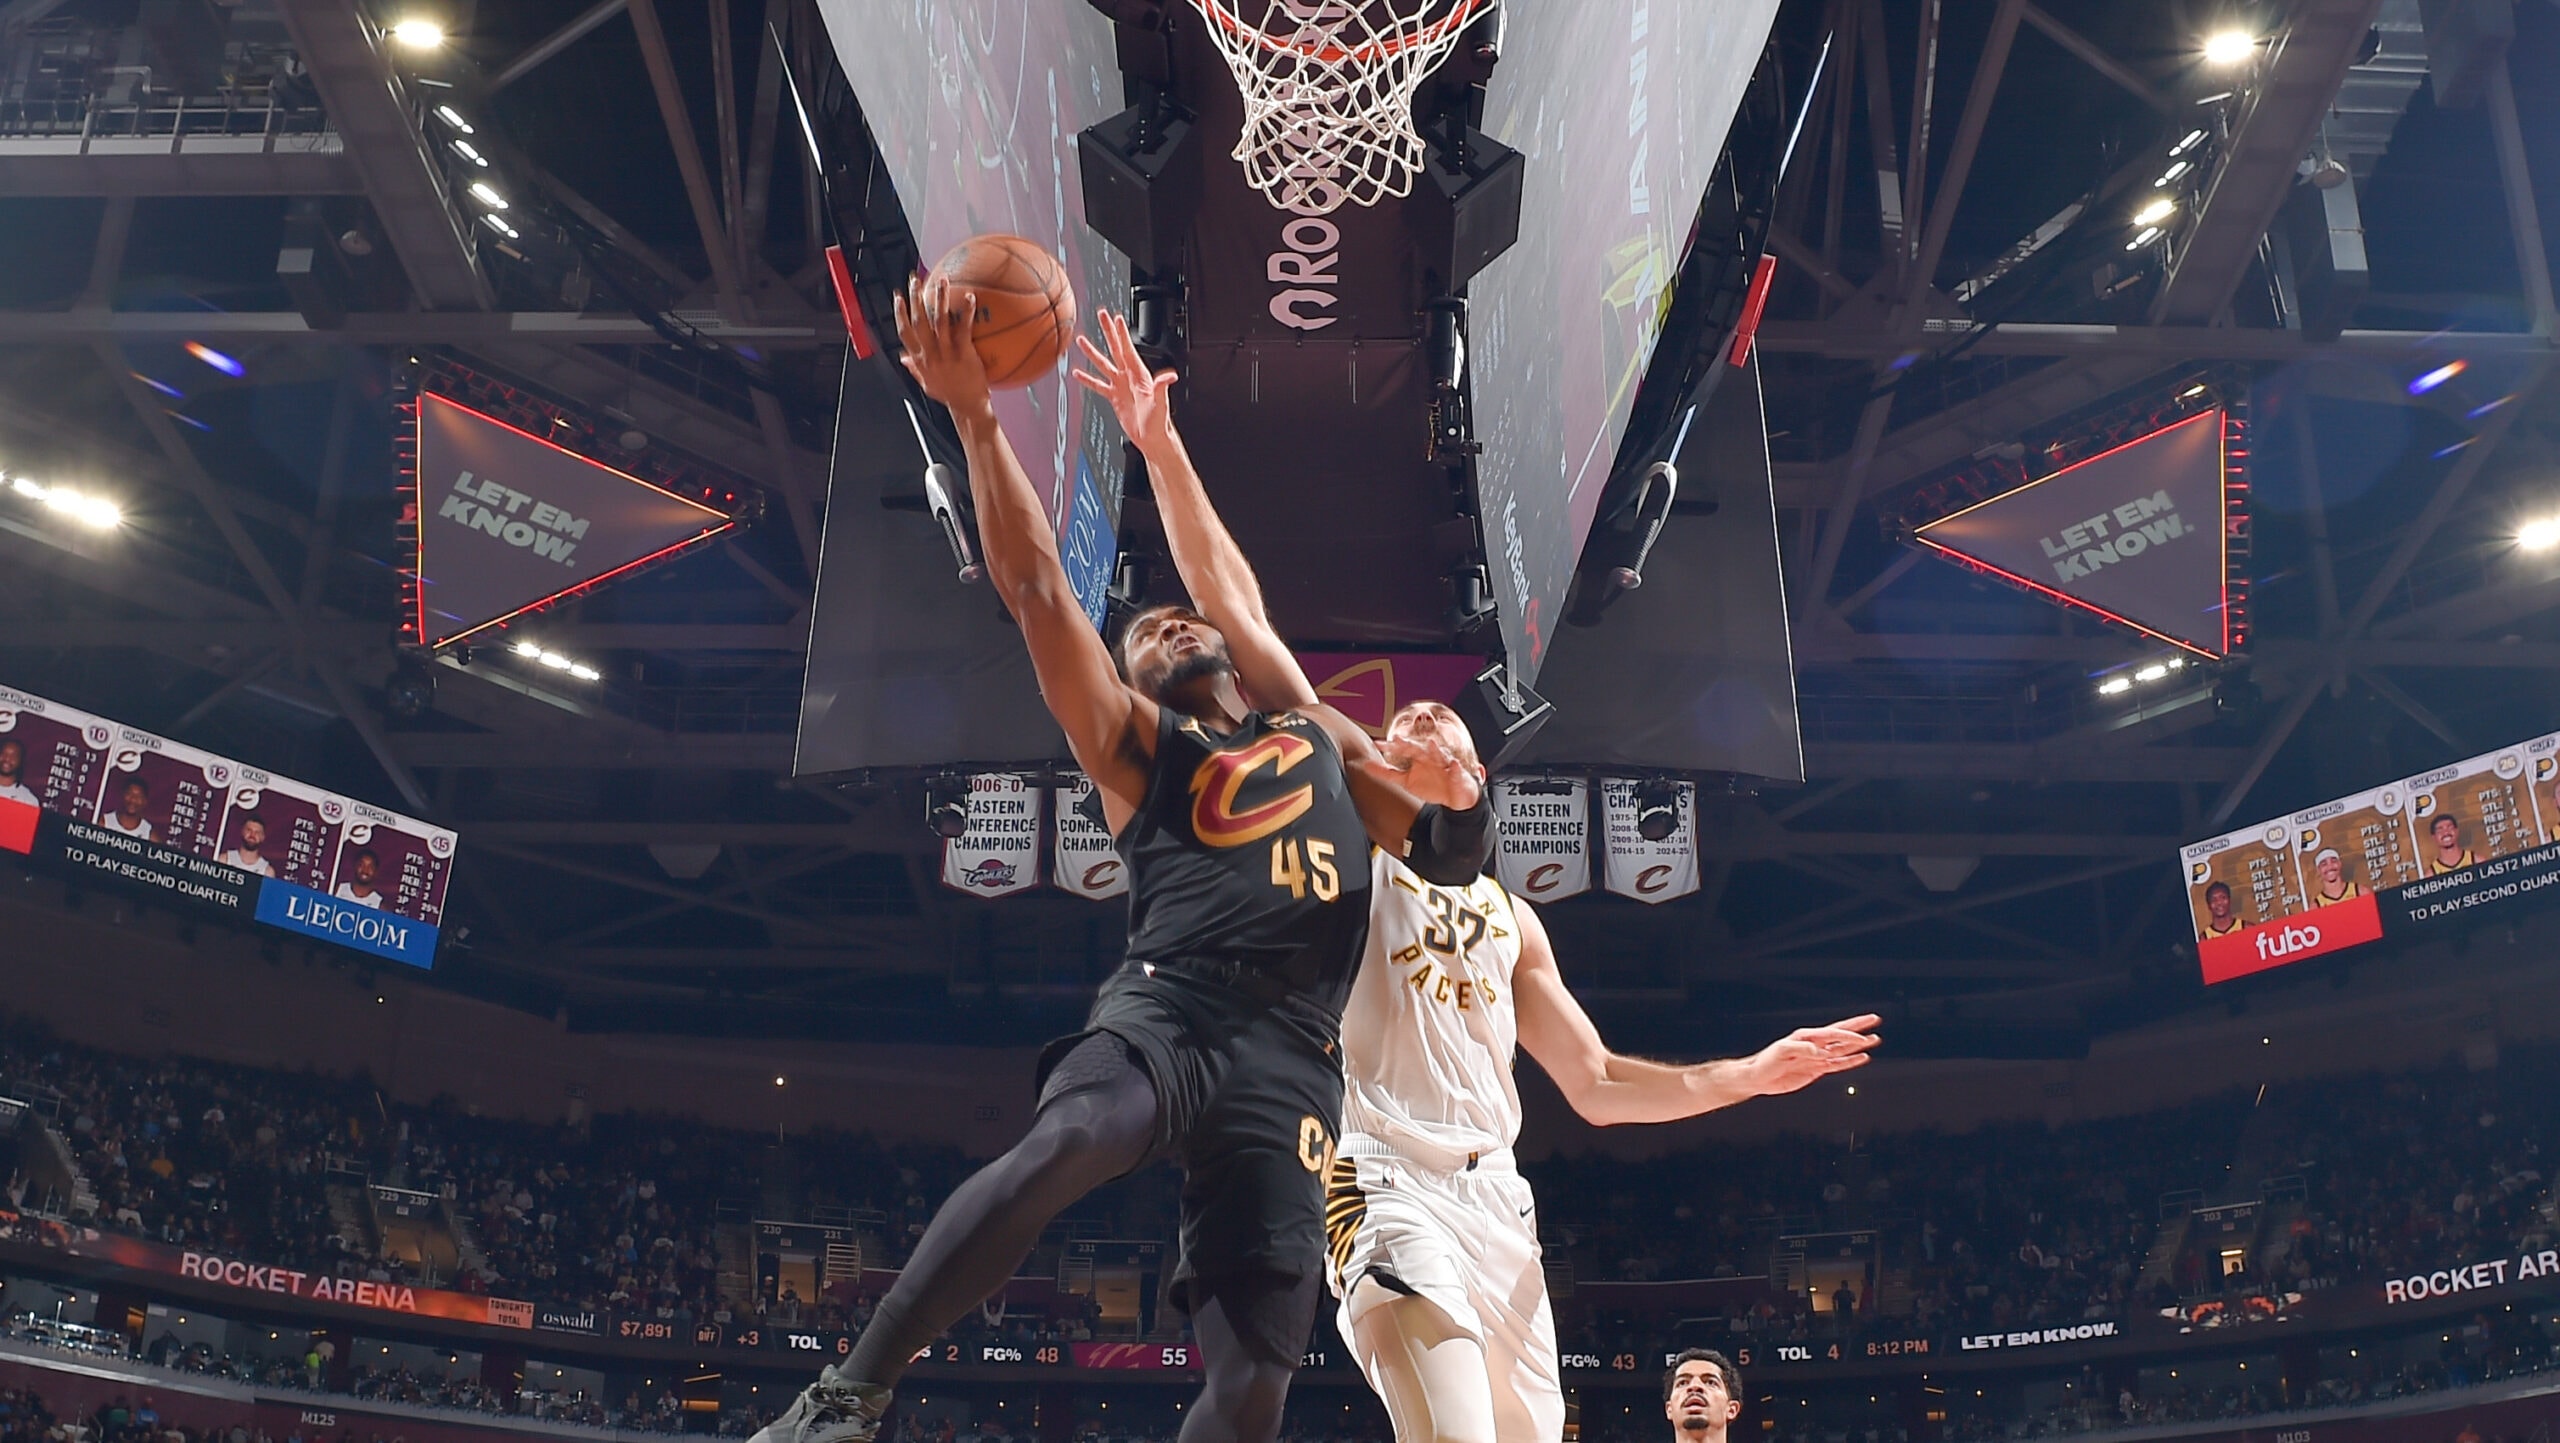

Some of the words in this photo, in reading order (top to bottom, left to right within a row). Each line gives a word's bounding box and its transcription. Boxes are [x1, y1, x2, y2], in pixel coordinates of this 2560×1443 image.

[453, 470, 533, 513] LET
[528, 502, 590, 540] EM
[439, 494, 577, 568] KNOW.
[2039, 512, 2110, 558] LET
[2113, 489, 2175, 525] EM
[2053, 513, 2195, 585] KNOW.
[90, 727, 107, 741] 10
[210, 766, 227, 780] 12
[2409, 767, 2458, 789] SHEPPARD
[2500, 756, 2516, 771] 26
[242, 768, 269, 784] WADE
[324, 802, 342, 817] 32
[1510, 804, 1570, 818] EASTERN
[1611, 814, 1638, 822] 1975-7
[2295, 802, 2344, 824] NEMBHARD
[2384, 794, 2393, 805] 2
[354, 805, 396, 826] MITCHELL
[432, 836, 450, 852] 45
[968, 818, 1036, 832] NFERENCE
[1500, 822, 1584, 836] CONFERENCE
[954, 836, 1031, 850] CHAMPIONS
[1063, 837, 1113, 851] CHAMPI
[1503, 840, 1581, 855] CHAMPIONS
[2187, 838, 2230, 857] MATHURIN
[65, 847, 84, 861] TO
[177, 880, 239, 908] QUARTER
[188, 859, 245, 886] MINUTES
[1271, 837, 1340, 904] 45
[2409, 907, 2428, 922] TO
[2255, 924, 2321, 960] fubo
[1391, 943, 1497, 1011] PACES
[763, 1225, 782, 1235] 230
[824, 1231, 842, 1240] 231
[1078, 1244, 1096, 1253] 231
[180, 1251, 307, 1296] ROCKET
[312, 1275, 416, 1312] ARENA
[2385, 1259, 2508, 1304] ROCKET
[490, 1299, 532, 1315] TONIGHT'S
[498, 1313, 520, 1326] TOTAL
[542, 1311, 595, 1329] oswald
[620, 1321, 673, 1339] $7,891
[736, 1331, 759, 1346] +3
[1961, 1335, 2004, 1350] LET
[2007, 1331, 2041, 1347] EM
[2043, 1322, 2119, 1343] KNOW.
[788, 1334, 823, 1350] TOL
[836, 1337, 849, 1354] 6
[1777, 1347, 1812, 1361] TOL
[1827, 1344, 1840, 1360] 4
[1867, 1341, 1899, 1356] 8:12
[1904, 1339, 1929, 1353] PM
[946, 1346, 958, 1362] 2
[983, 1347, 1022, 1362] FG%
[1035, 1347, 1059, 1363] 48
[1161, 1349, 1187, 1366] 55
[1561, 1354, 1600, 1368] FG%
[1612, 1354, 1636, 1370] 43
[1738, 1349, 1750, 1365] 5
[301, 1411, 336, 1427] M125
[2276, 1430, 2311, 1443] M103
